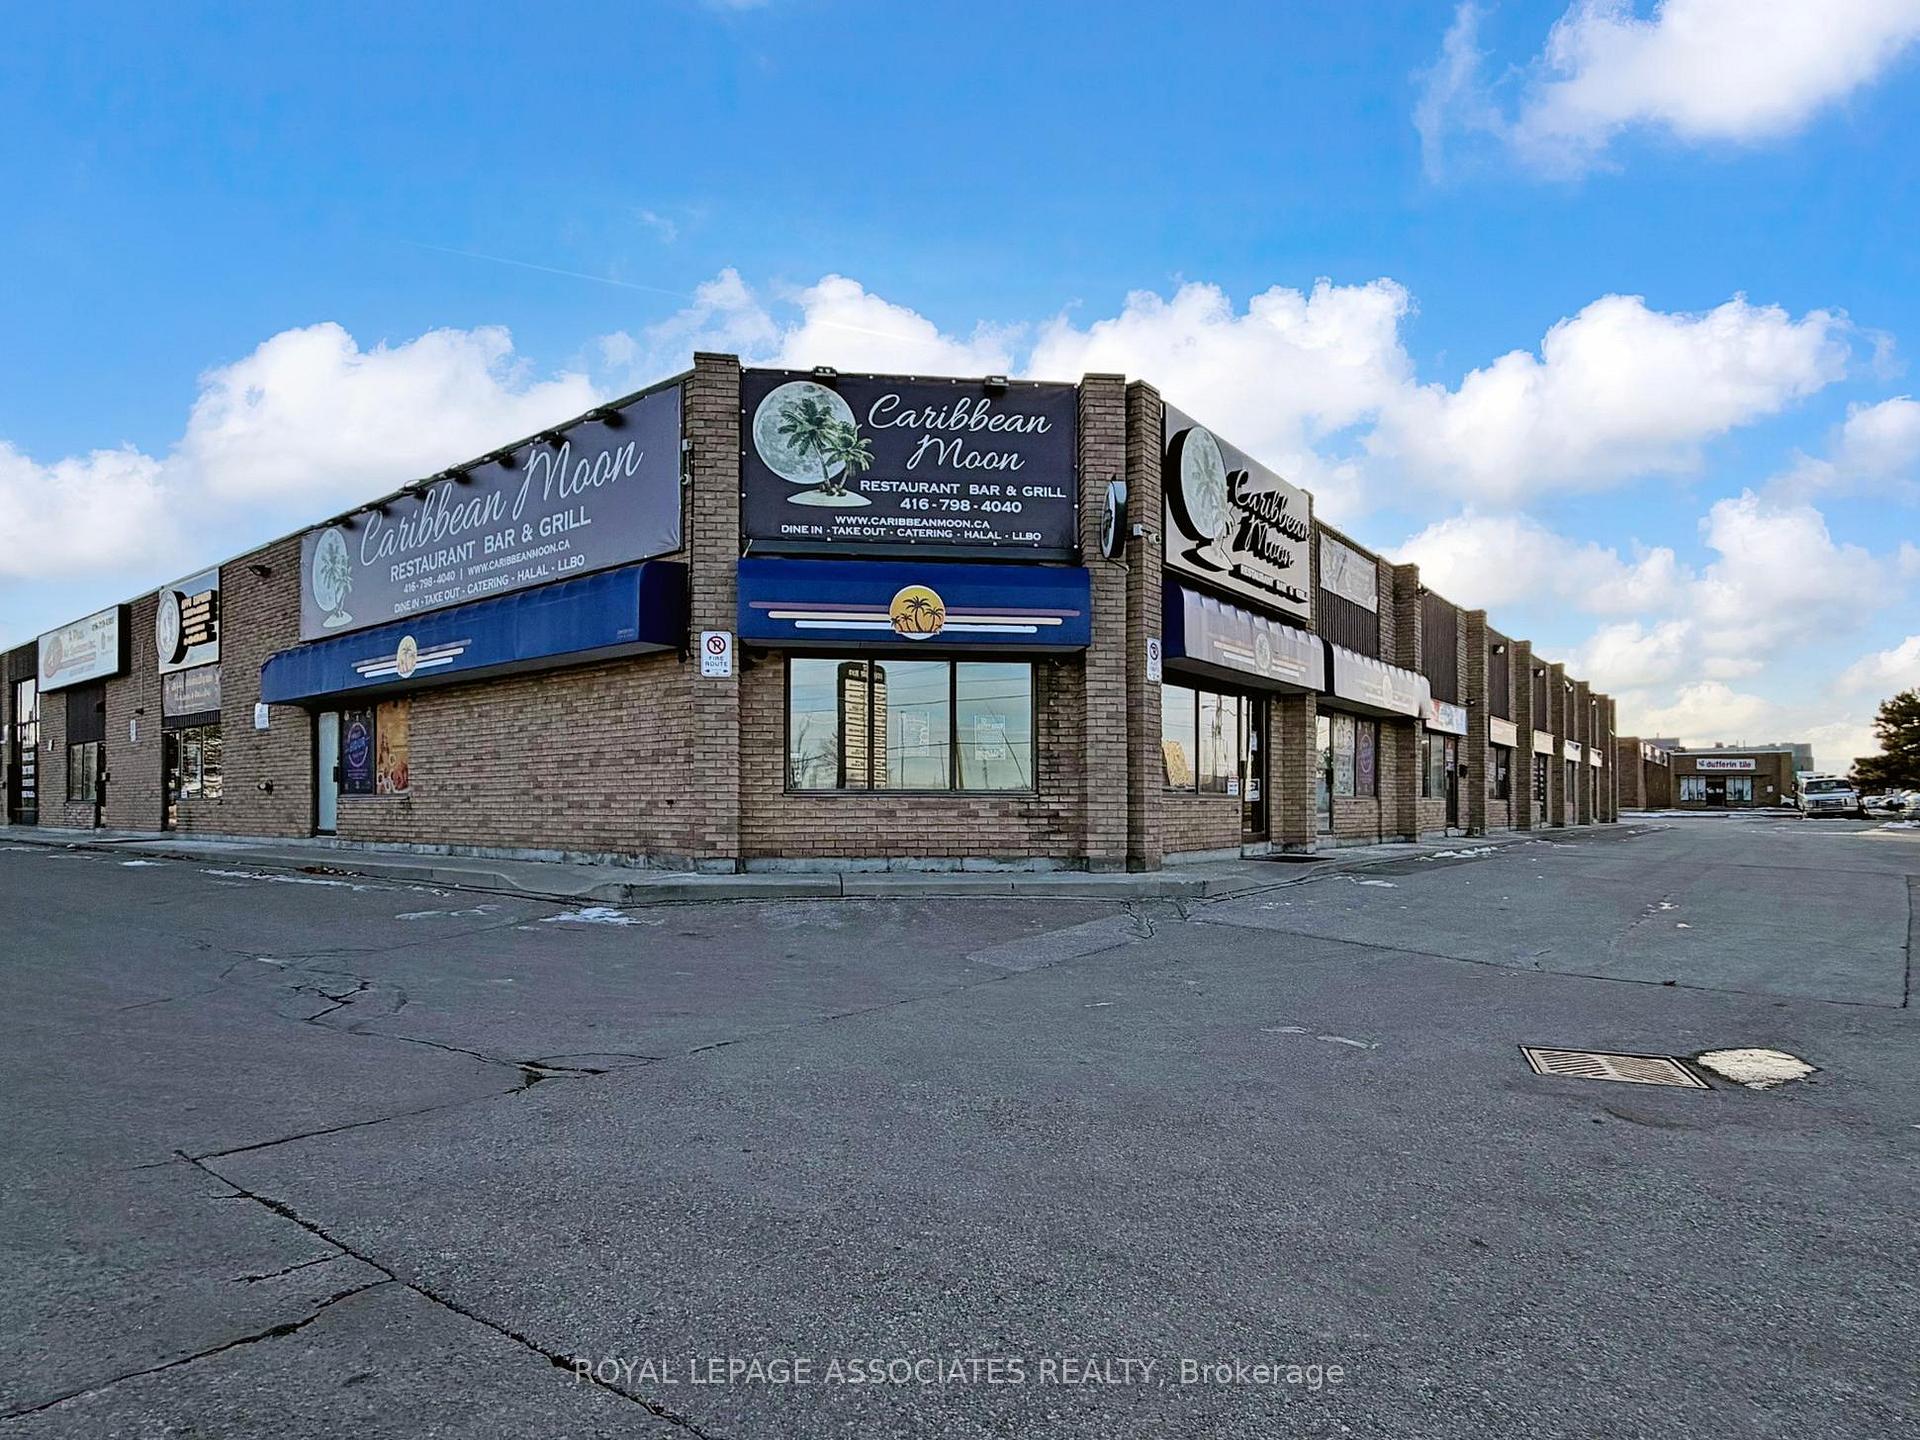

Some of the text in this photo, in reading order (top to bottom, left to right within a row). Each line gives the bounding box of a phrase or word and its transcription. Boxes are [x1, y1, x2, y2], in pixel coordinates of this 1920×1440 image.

[869, 394, 1052, 433] Caribbean
[907, 434, 1026, 471] Moon
[360, 441, 644, 566] Caribbean Moon
[860, 480, 1067, 498] RESTAURANT BAR & GRILL
[1234, 469, 1310, 540] Caribbean
[781, 525, 1041, 541] DINE IN TAKE OUT CATERING HALAL LLBO
[835, 516, 990, 529] WWW.CARIBBEANMOON.CA
[1244, 516, 1295, 567] Moon
[390, 506, 591, 582] RESTAURANT BAR & GRILL
[467, 540, 570, 576] WWW.CARIBBEANMOON.CA
[394, 601, 411, 614] DINE
[424, 592, 443, 608] TAKE
[444, 588, 460, 601] OUT
[467, 575, 509, 595] CATERING
[517, 566, 549, 582] HALAL
[558, 554, 585, 571] LLBO
